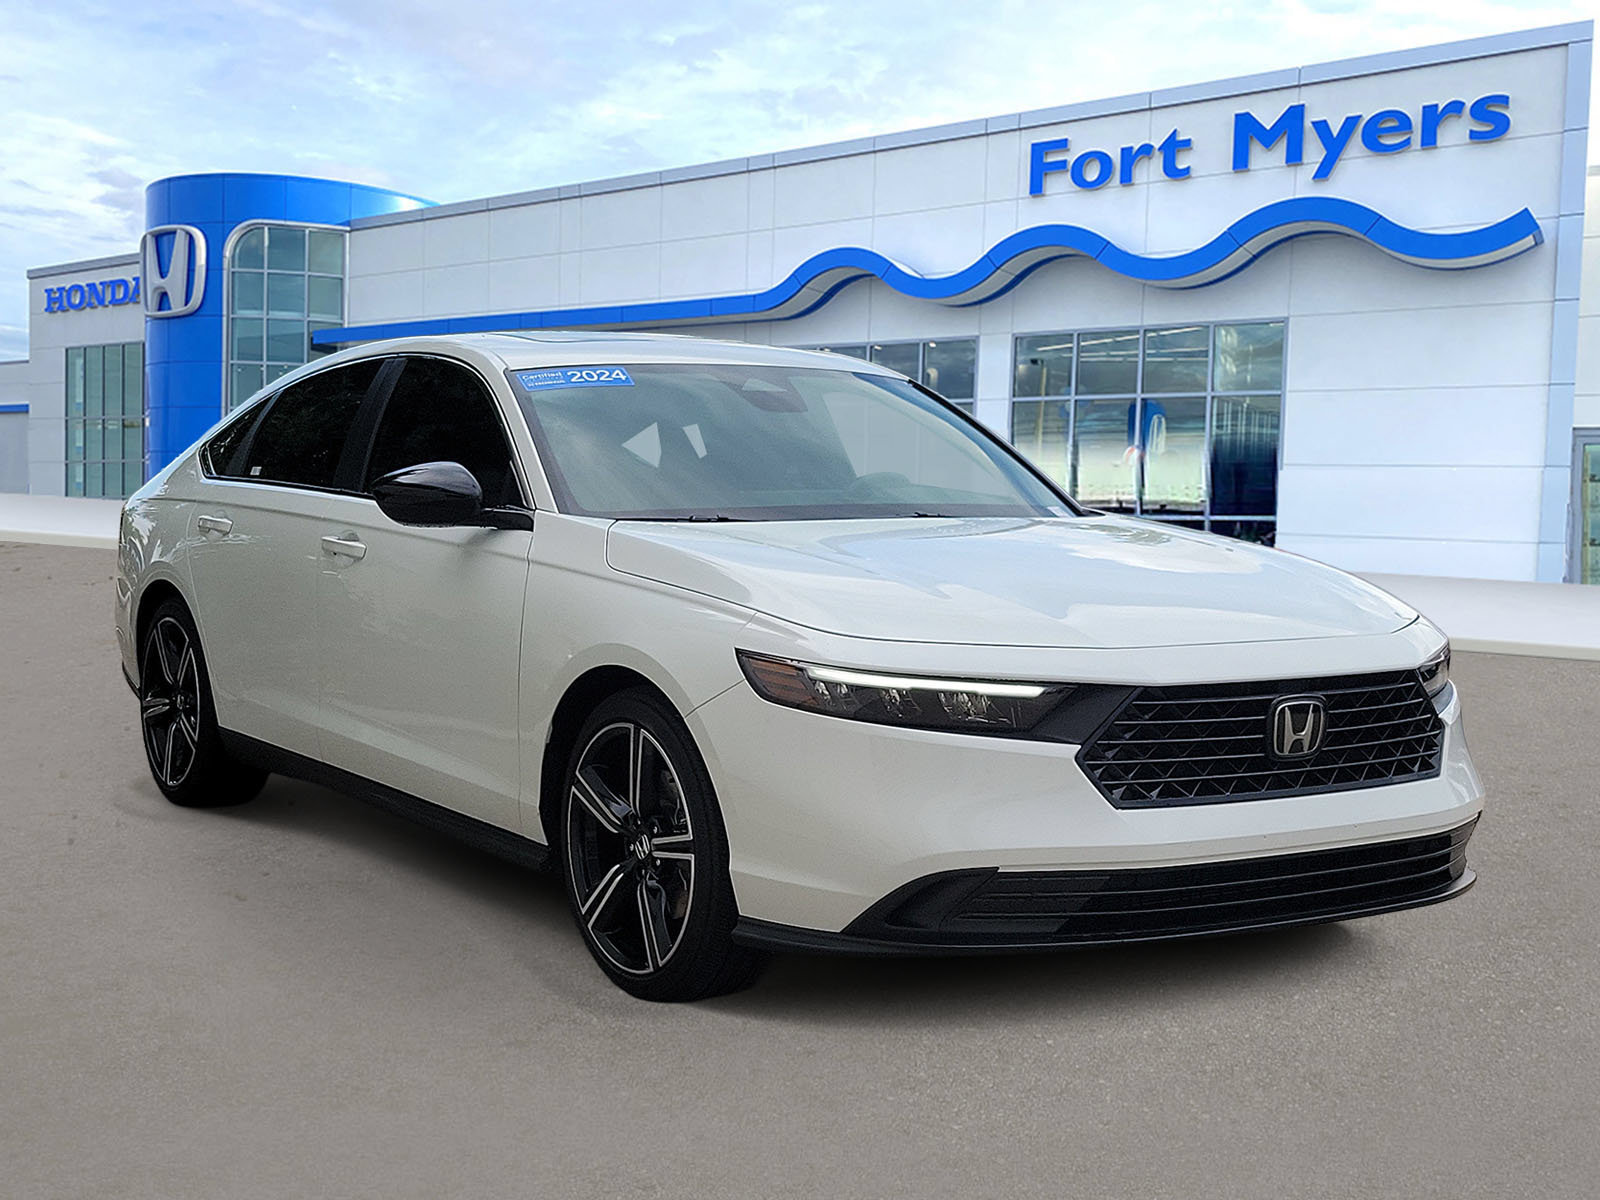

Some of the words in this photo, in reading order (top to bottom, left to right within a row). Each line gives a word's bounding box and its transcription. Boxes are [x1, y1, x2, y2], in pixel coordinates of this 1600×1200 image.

[1029, 129, 1193, 196] Fort
[1232, 94, 1511, 180] Myers
[567, 369, 627, 383] 2024
